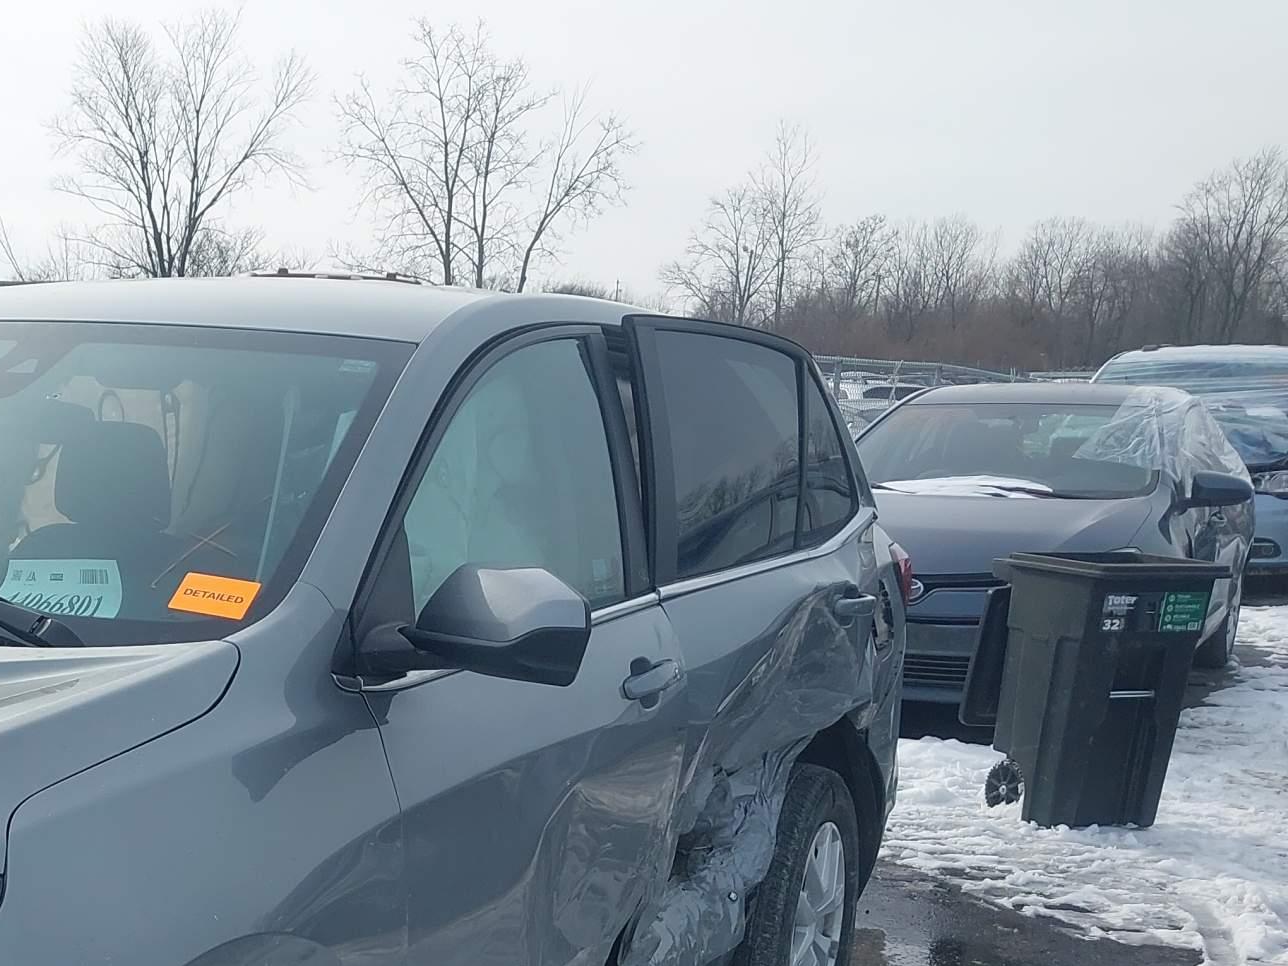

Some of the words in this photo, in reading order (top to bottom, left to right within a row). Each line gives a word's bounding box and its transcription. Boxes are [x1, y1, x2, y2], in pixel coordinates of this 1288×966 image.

[183, 588, 244, 604] DETAILED
[1107, 595, 1139, 605] Toter
[1101, 619, 1121, 630] 32
